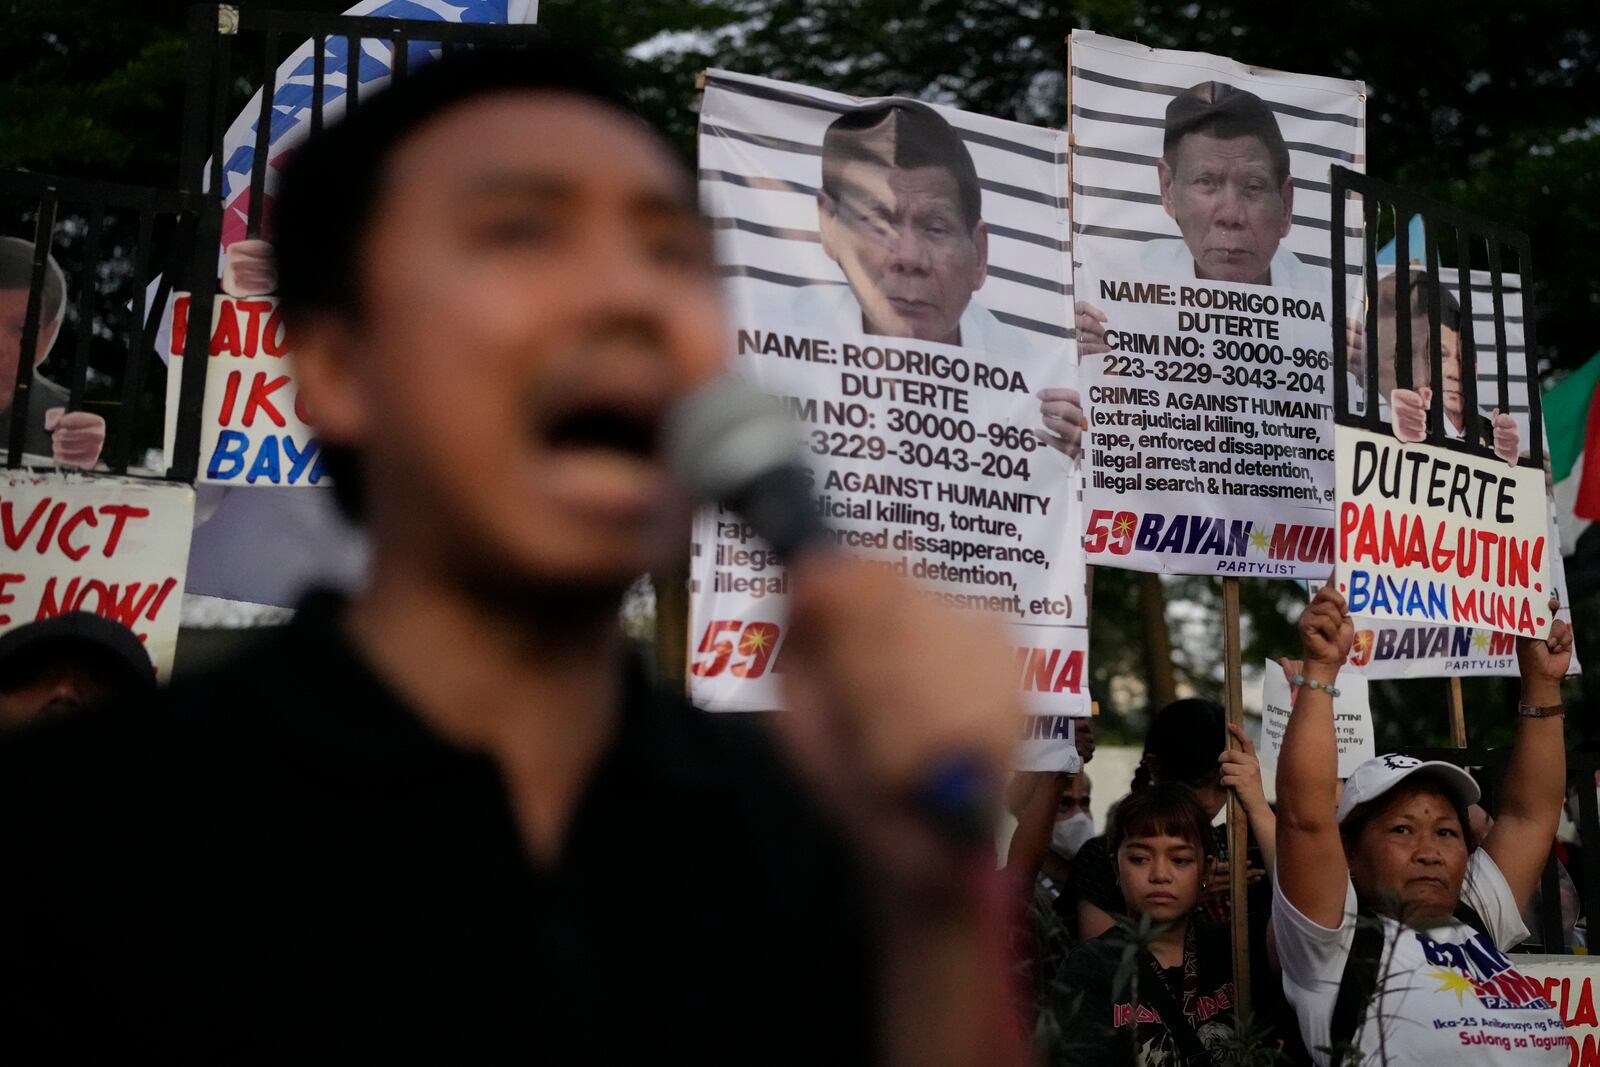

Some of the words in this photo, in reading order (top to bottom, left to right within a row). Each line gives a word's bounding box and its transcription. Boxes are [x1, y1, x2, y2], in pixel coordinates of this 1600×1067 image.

[1100, 279, 1176, 305] NAME:
[1180, 286, 1279, 316] RODRIGO
[1283, 297, 1325, 322] ROA
[1104, 329, 1160, 356] CRIM
[1164, 336, 1205, 358] NO:
[1178, 311, 1280, 341] DUTERTE
[737, 329, 837, 365] NAME:
[843, 344, 970, 383] RODRIGO
[974, 366, 1029, 394] ROA
[1103, 355, 1325, 395] 223-3229-3043-204
[841, 372, 969, 414] DUTERTE
[1089, 386, 1160, 407] CRIMES
[1166, 392, 1249, 413] AGAINST
[824, 400, 876, 429] NO:
[887, 408, 1047, 452] 30000-966-
[1091, 406, 1200, 432] (extrajudicial
[1204, 415, 1259, 439] killing,
[1261, 420, 1320, 444] torture,
[1091, 431, 1134, 452] rape,
[1138, 432, 1216, 453] enforced
[799, 430, 1030, 482] -3229-3043-204
[1092, 450, 1141, 473] illegal
[1145, 455, 1196, 472] arrest
[1199, 457, 1232, 475] and
[1234, 458, 1313, 483] detention,
[824, 470, 933, 501] AGAINST
[937, 482, 1051, 516] HUMANITY
[1092, 470, 1141, 494] illegal
[1145, 476, 1204, 494] search
[1207, 477, 1220, 495] &
[1222, 478, 1322, 503] harassment,
[1352, 441, 1517, 524] DUTERTE
[876, 501, 945, 532] killing,
[949, 511, 1023, 541] torture,
[1083, 508, 1138, 556] 59
[1135, 513, 1253, 557] BAYAN
[1268, 523, 1335, 565] MUN
[716, 521, 753, 545] rap
[892, 531, 1051, 569] dissapperance,
[1339, 501, 1545, 593] PANAGUTIN!
[912, 558, 1018, 591] detention,
[1217, 559, 1296, 575] PARTYLIST
[713, 570, 789, 599] illegal
[1029, 594, 1073, 619] etc)
[690, 620, 780, 679] 59
[1374, 626, 1473, 661] BAYAN
[1445, 658, 1514, 671] PARTYLIST
[1459, 1030, 1511, 1051] Sulong
[1514, 1037, 1527, 1048] sa
